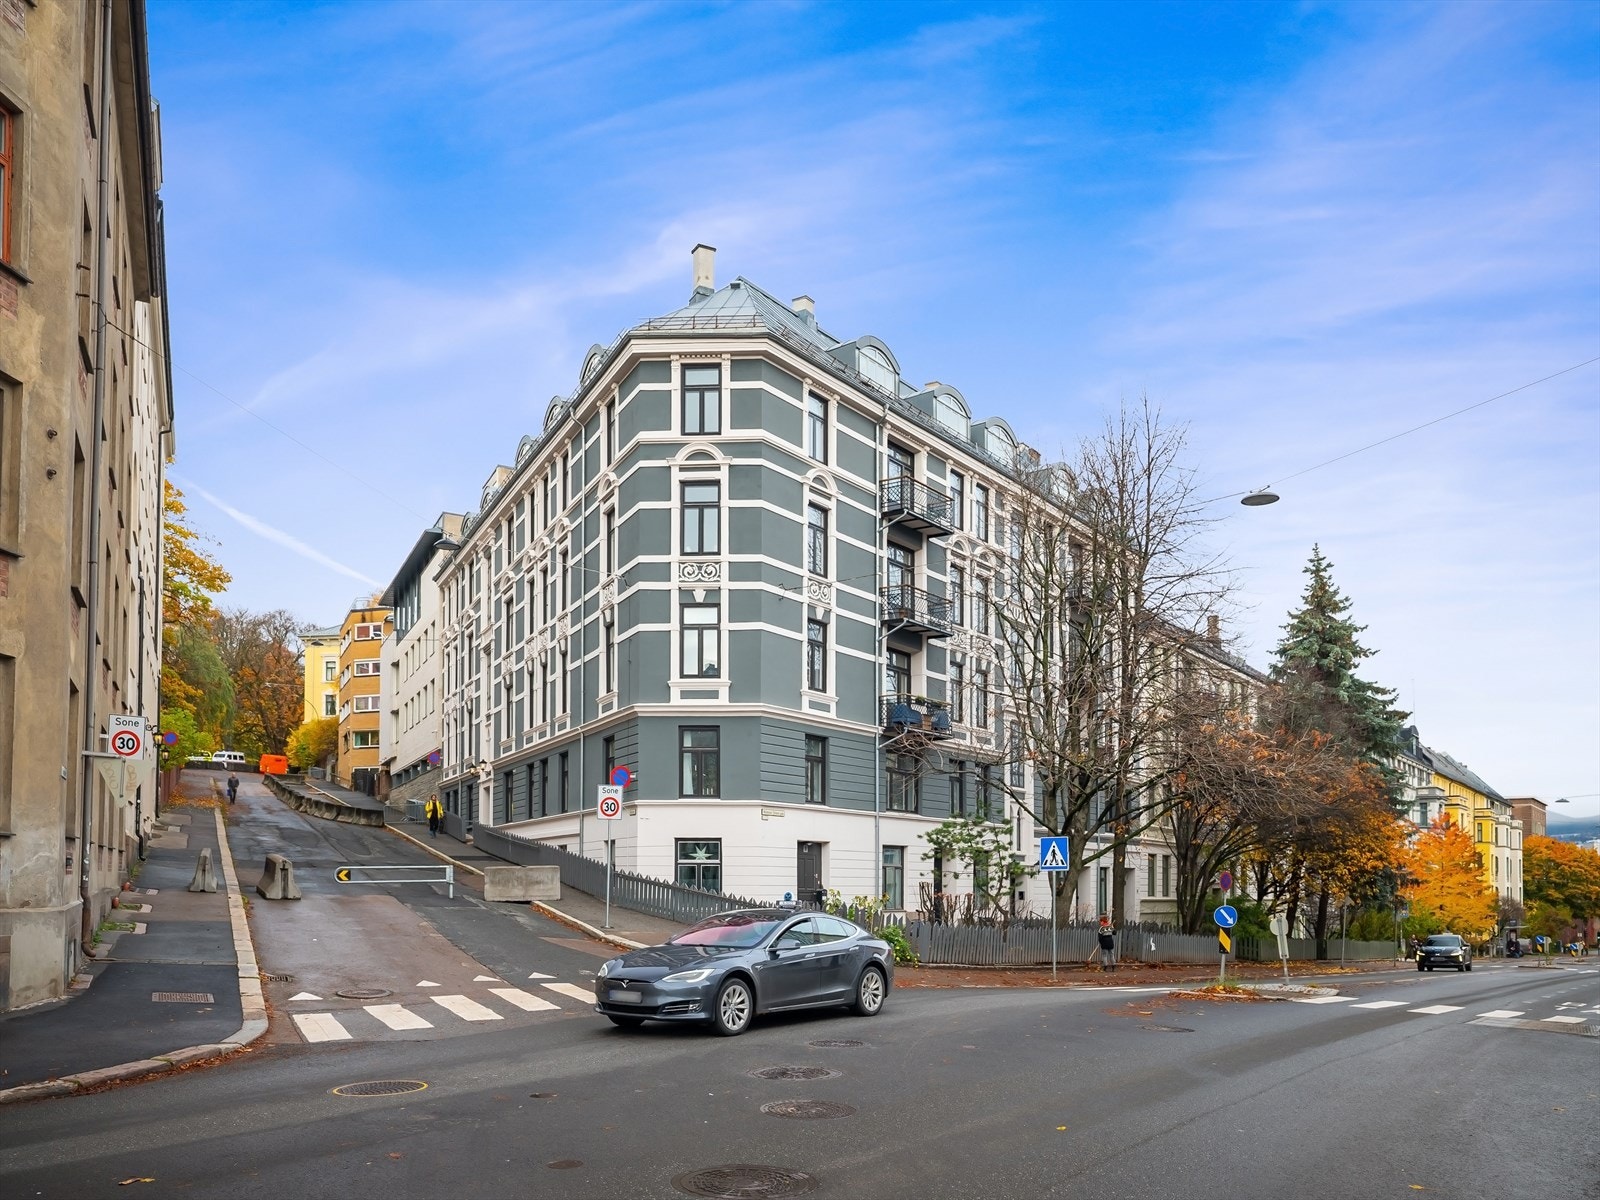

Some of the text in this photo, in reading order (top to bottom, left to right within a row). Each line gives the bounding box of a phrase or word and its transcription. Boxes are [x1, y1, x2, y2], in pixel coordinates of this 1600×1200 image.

[115, 717, 140, 727] Sone
[117, 736, 135, 750] 30
[603, 802, 616, 812] 30
